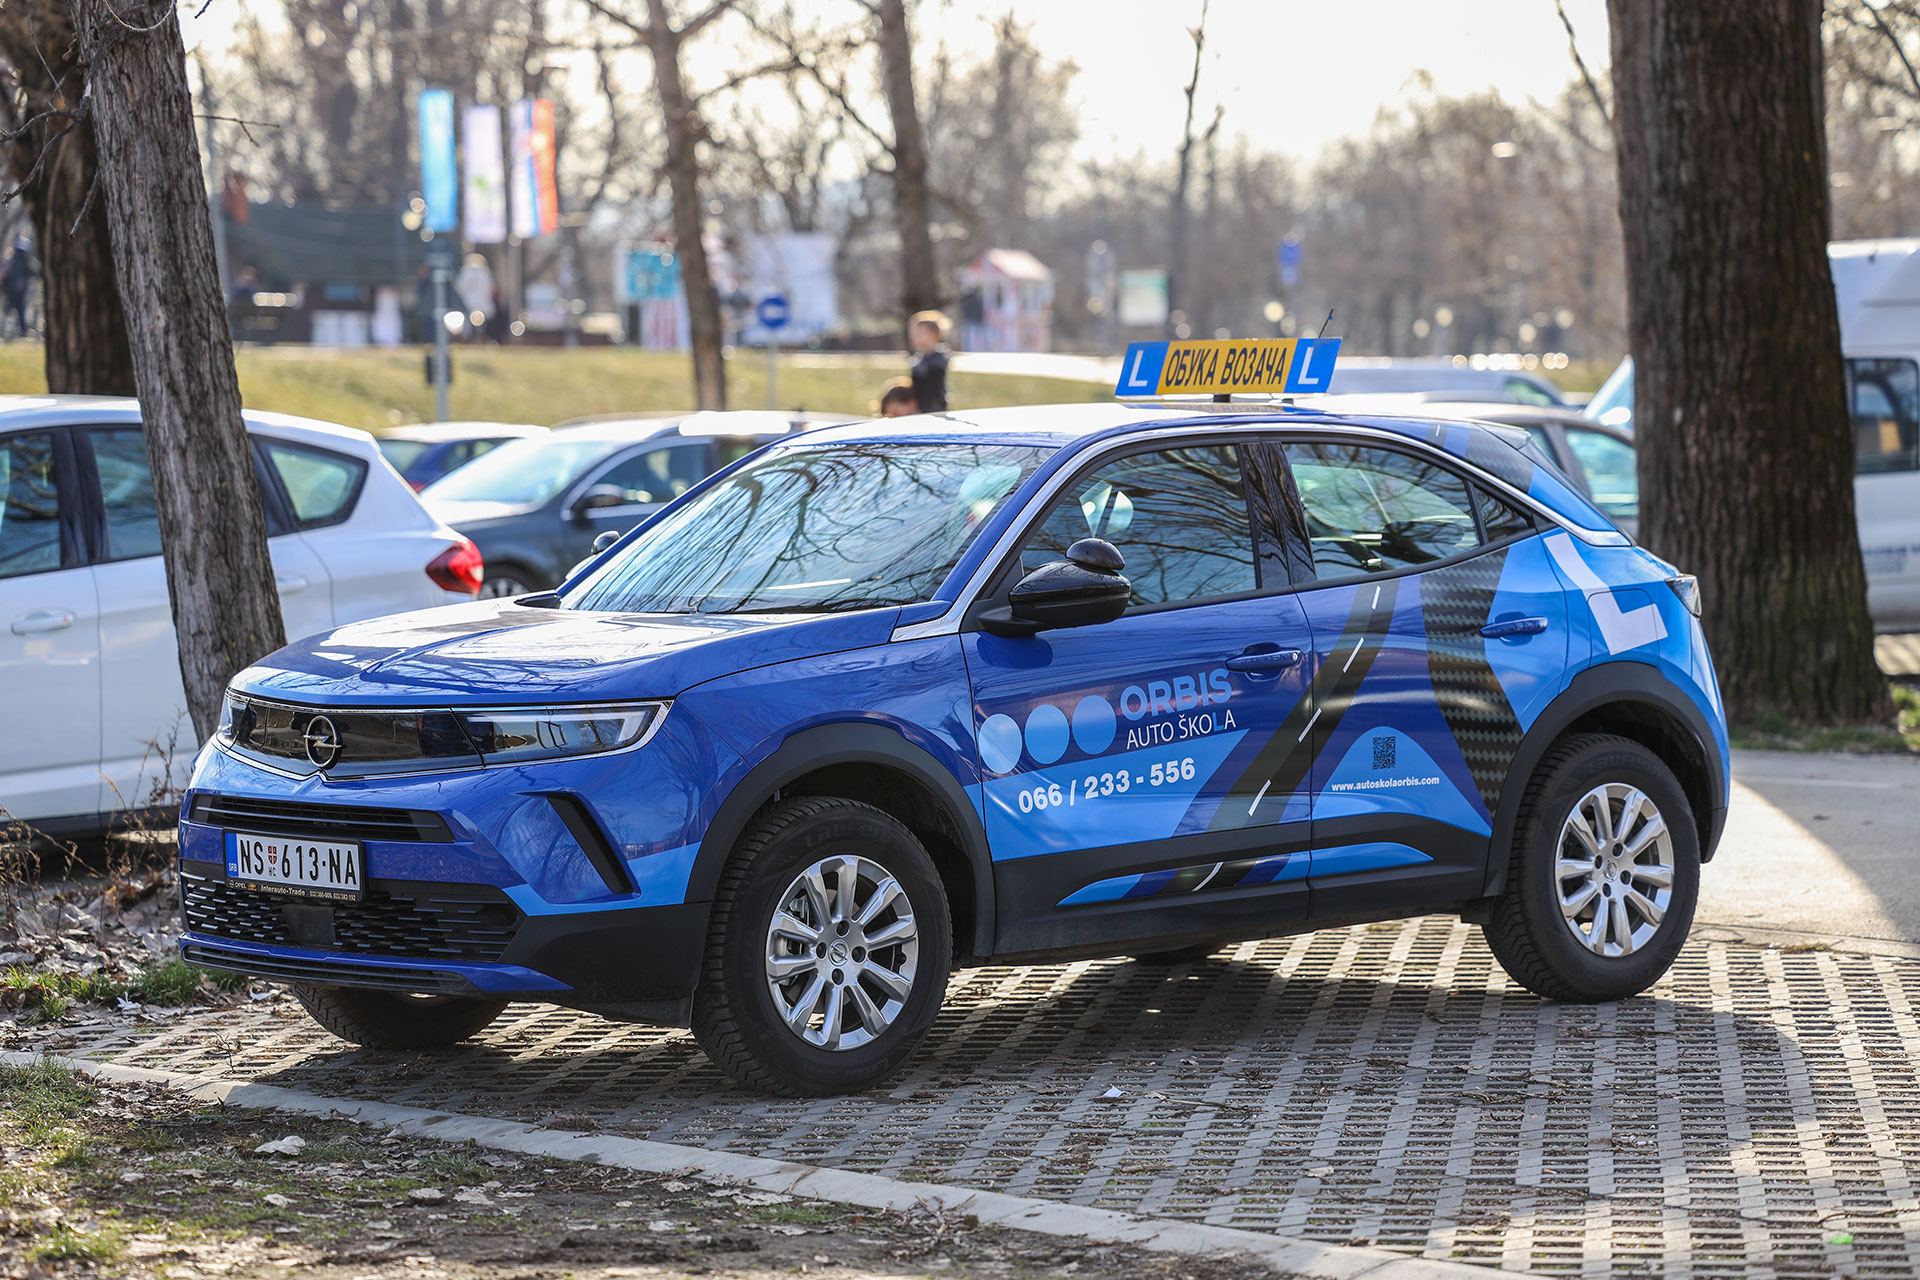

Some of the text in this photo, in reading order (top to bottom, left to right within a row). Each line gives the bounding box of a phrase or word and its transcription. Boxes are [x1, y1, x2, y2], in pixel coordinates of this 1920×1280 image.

[1128, 346, 1319, 387] L ОБУКА ВОЗАЧА L
[1120, 668, 1233, 721] ORBIS
[1126, 709, 1237, 750] AUTO ŠKOLA
[1018, 783, 1063, 814] 066
[1084, 769, 1130, 799] 233
[1149, 757, 1196, 787] 556
[1331, 776, 1440, 792] www.autoskolaorbis.com
[240, 839, 264, 875] NS
